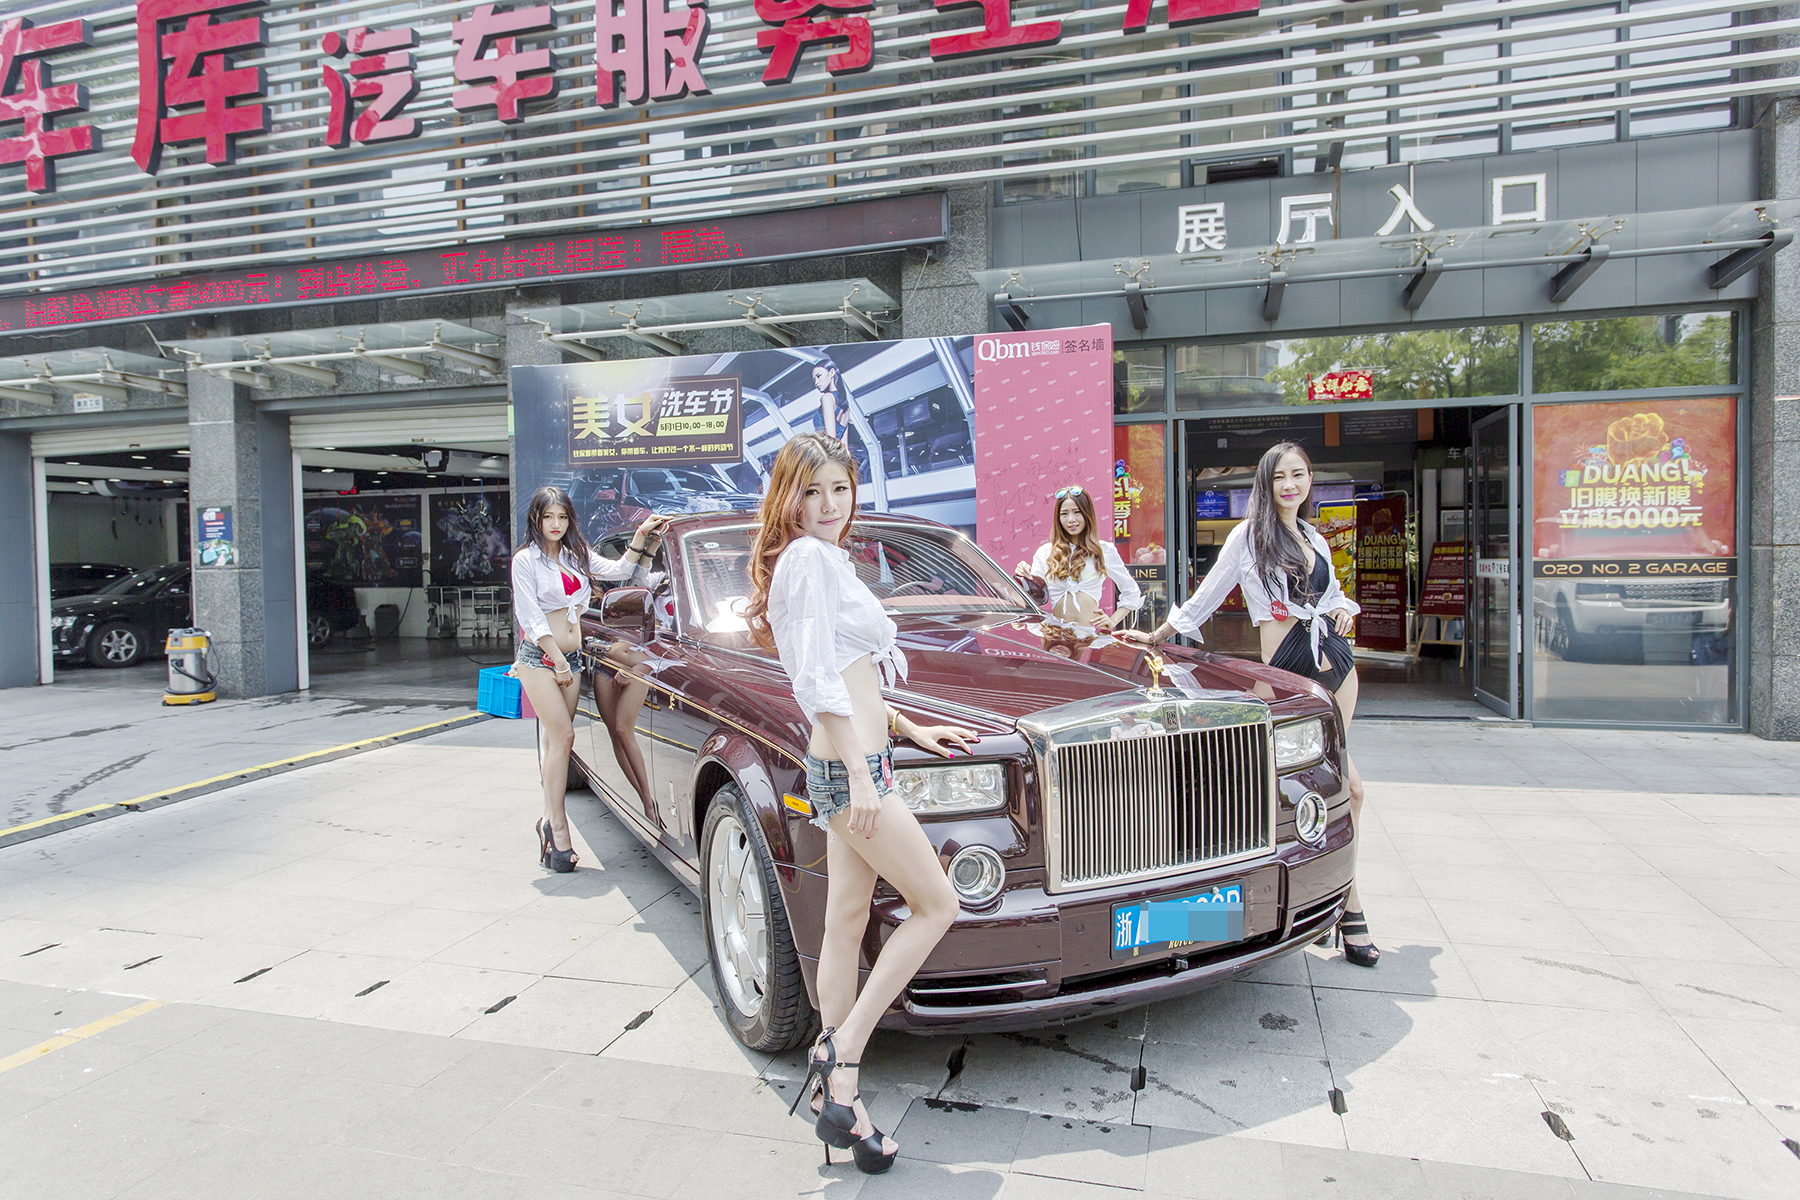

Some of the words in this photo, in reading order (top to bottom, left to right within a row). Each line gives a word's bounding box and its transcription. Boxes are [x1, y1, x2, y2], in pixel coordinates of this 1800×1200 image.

[1176, 173, 1548, 253] 展厅入口
[978, 338, 1030, 362] Qbm
[1065, 338, 1105, 354] 签名墙
[659, 387, 735, 418] 洗车节
[573, 392, 654, 440] 美女
[1583, 458, 1690, 485] DUANG!
[1570, 485, 1691, 508] 旧膜换新膜
[1559, 506, 1703, 530] 立减5000元
[1363, 532, 1401, 546] DUANG!
[1646, 562, 1728, 574] GARAGE
